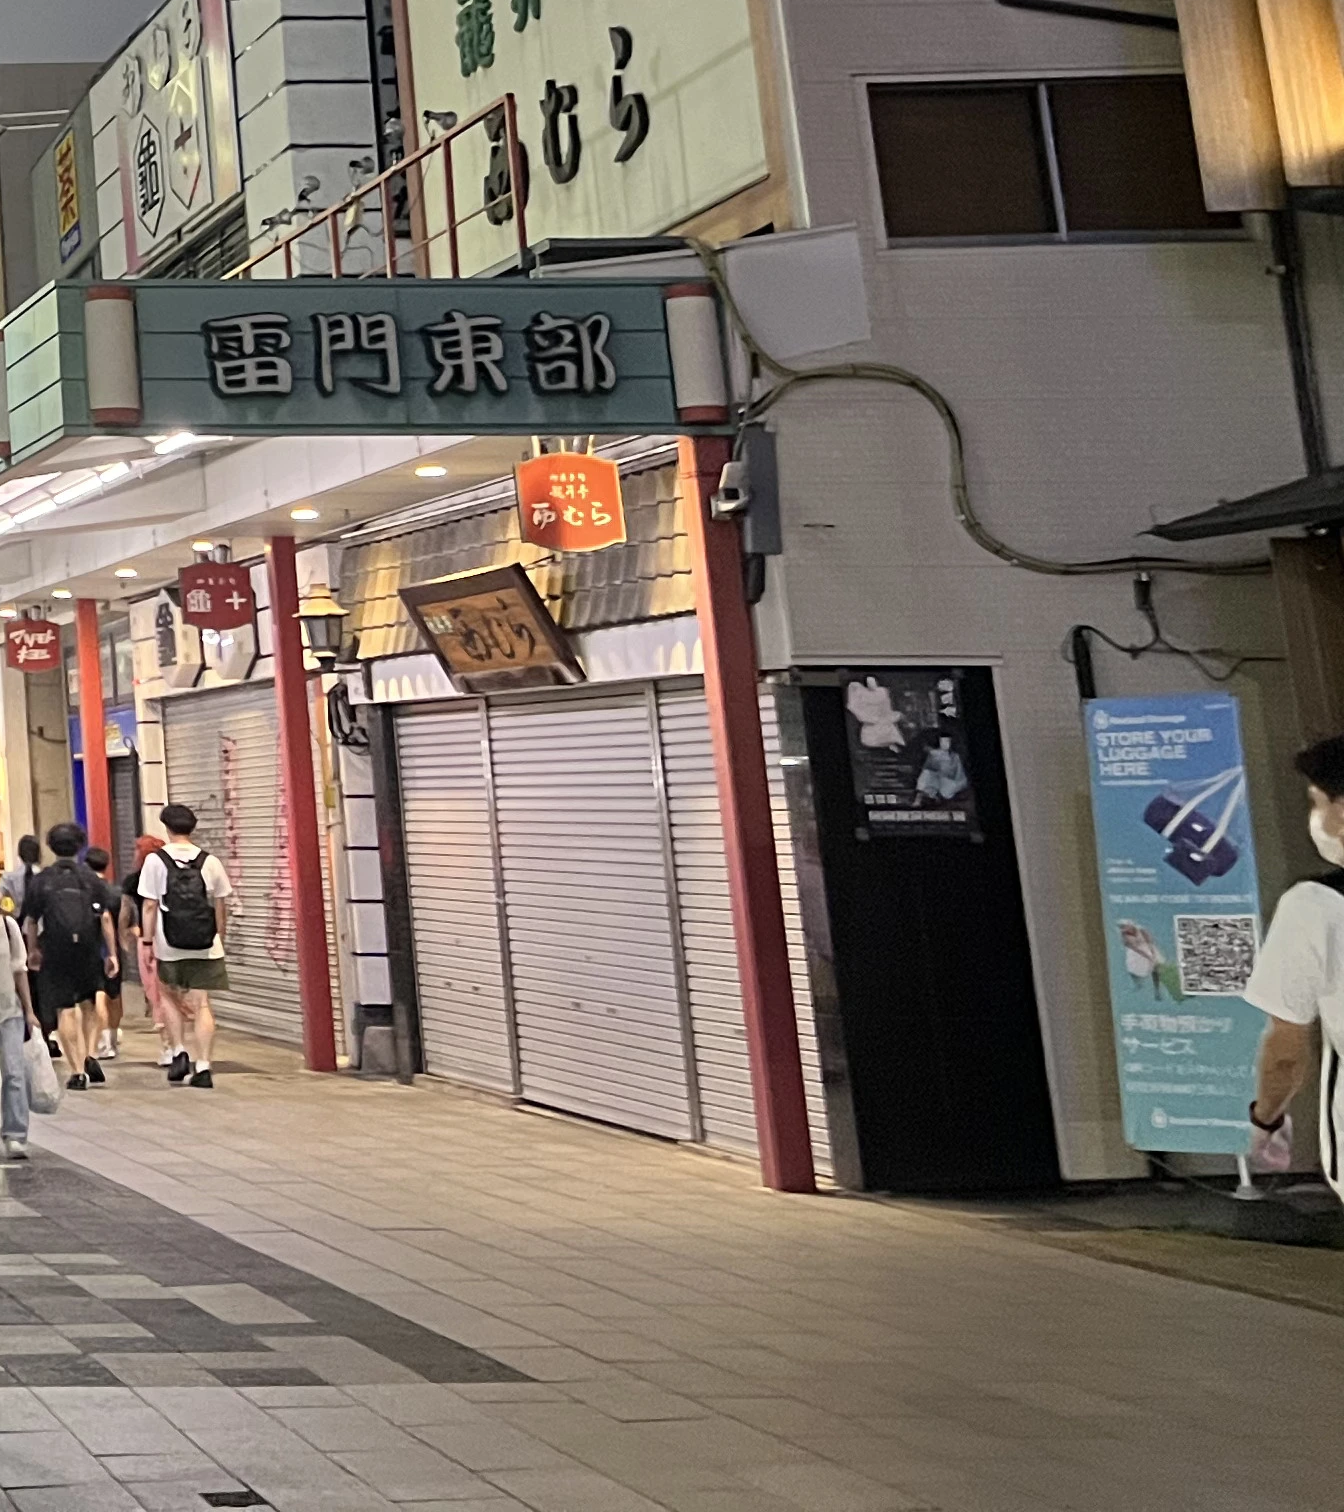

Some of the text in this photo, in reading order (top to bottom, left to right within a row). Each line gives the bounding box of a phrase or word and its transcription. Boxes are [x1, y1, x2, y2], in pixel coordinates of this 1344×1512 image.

[205, 309, 617, 395] 雷門東部
[1096, 728, 1213, 747] STORE YOUR
[1097, 745, 1187, 762] LUGGAGE
[1099, 762, 1152, 777] HERE
